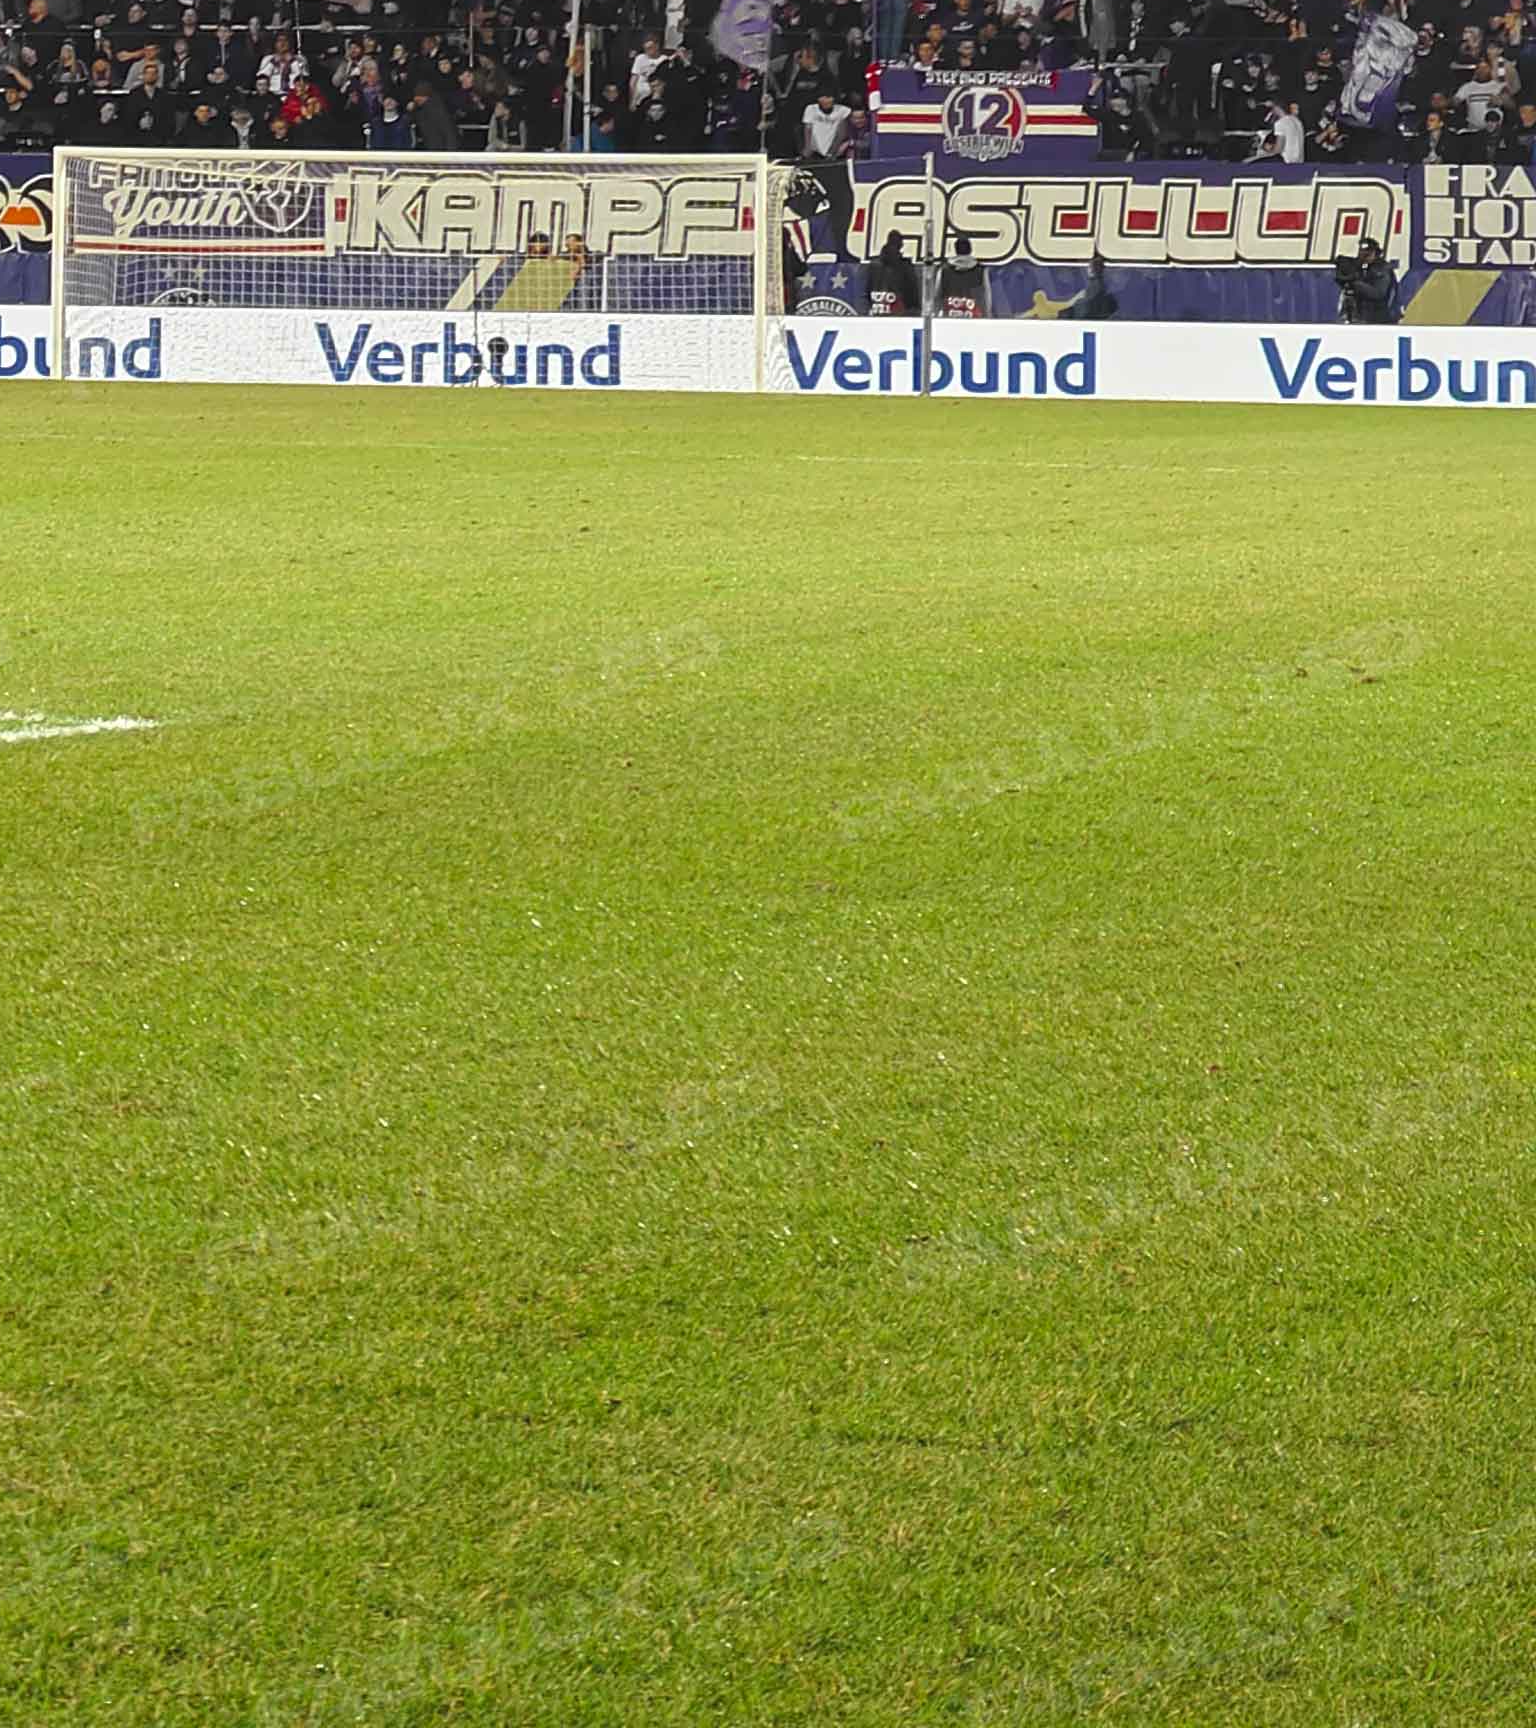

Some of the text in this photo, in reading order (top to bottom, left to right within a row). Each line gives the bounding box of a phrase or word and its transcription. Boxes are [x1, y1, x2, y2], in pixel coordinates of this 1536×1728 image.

[954, 92, 1012, 137] 12
[102, 187, 248, 240] Youth
[345, 165, 751, 263] KAMPF
[1423, 197, 1536, 239] HO
[314, 321, 623, 388] Verbund
[786, 328, 1097, 396] Verbund
